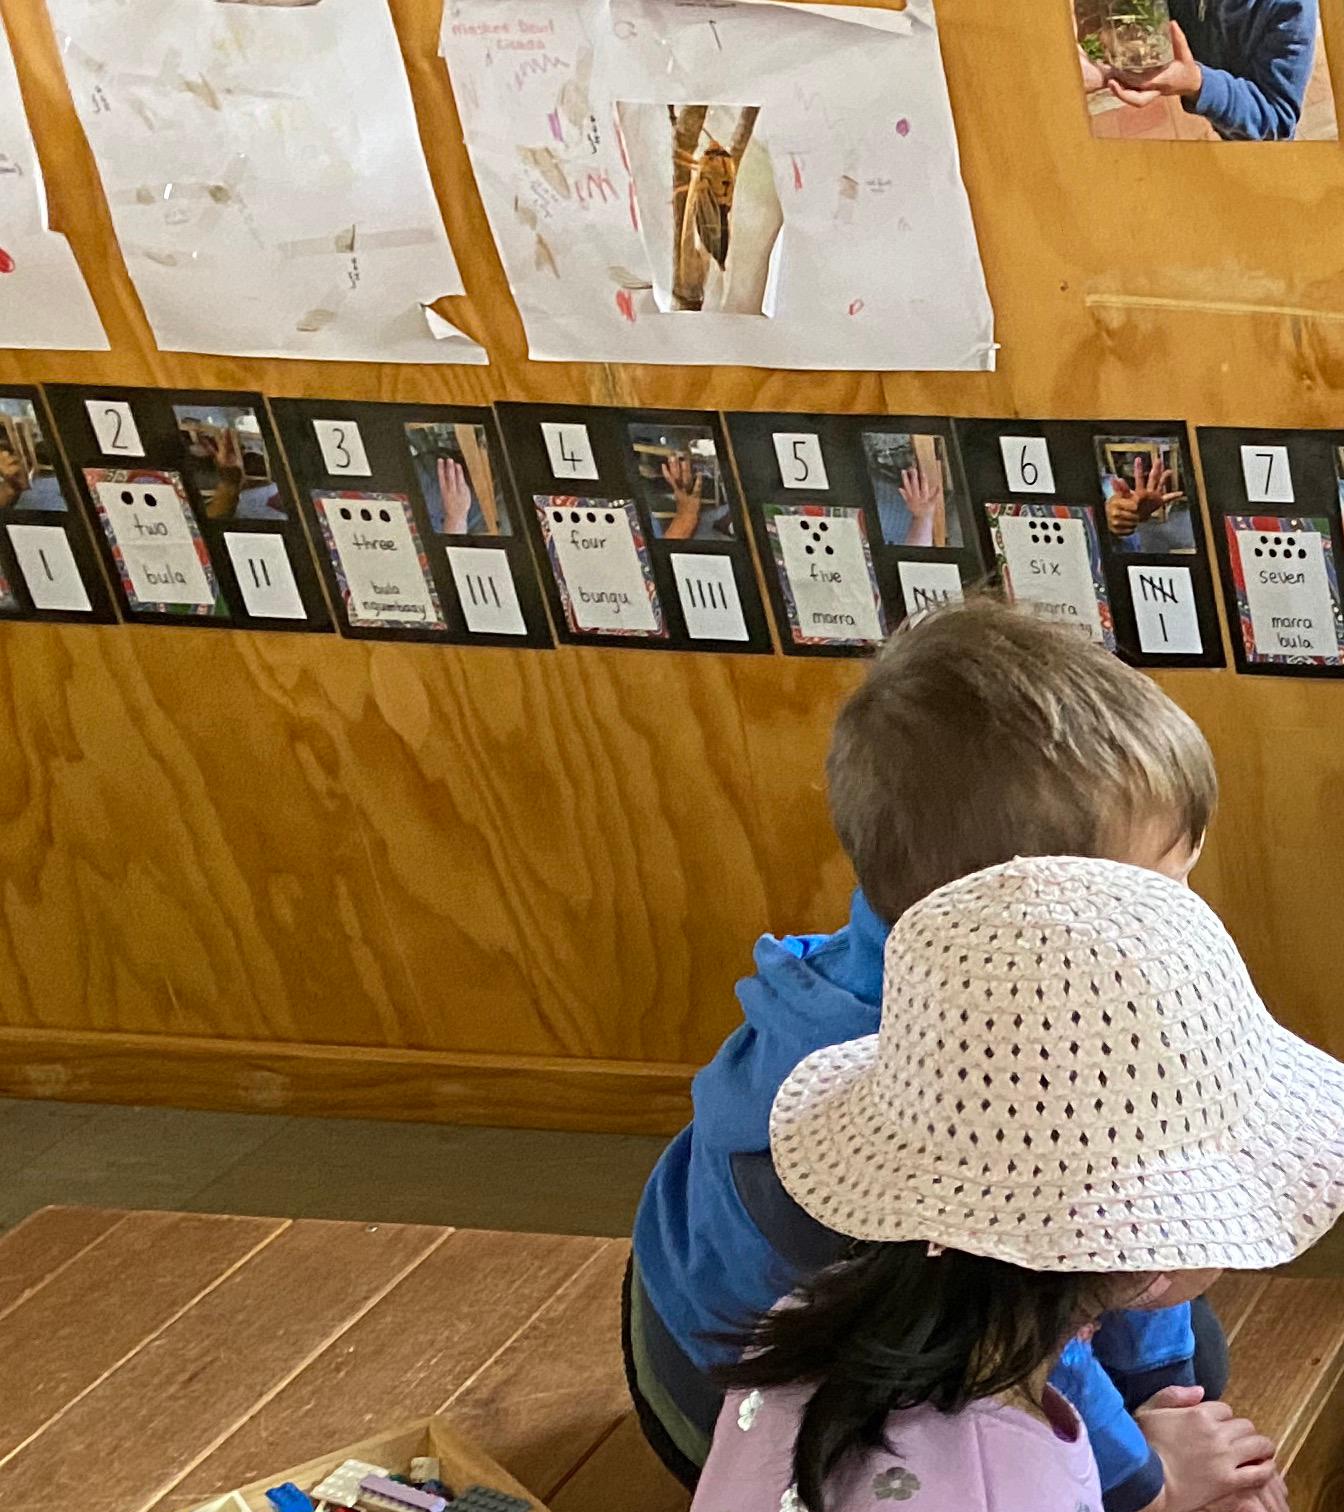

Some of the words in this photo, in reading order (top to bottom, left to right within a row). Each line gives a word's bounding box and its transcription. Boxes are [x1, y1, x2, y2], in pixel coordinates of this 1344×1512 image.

[104, 408, 128, 450] 2
[331, 427, 351, 468] 3
[558, 431, 583, 472] 4
[792, 440, 809, 482] 5
[1019, 444, 1038, 486] 6
[1255, 453, 1274, 495] 7
[132, 513, 168, 536] two
[352, 533, 398, 552] three
[570, 529, 607, 550] four
[142, 564, 187, 585] bula
[809, 563, 842, 583] five
[1030, 558, 1061, 577] six
[1259, 569, 1305, 585] seven
[578, 586, 632, 614] bungu
[812, 612, 856, 626] marra
[1271, 616, 1313, 629] marra
[1277, 632, 1314, 649] bula
